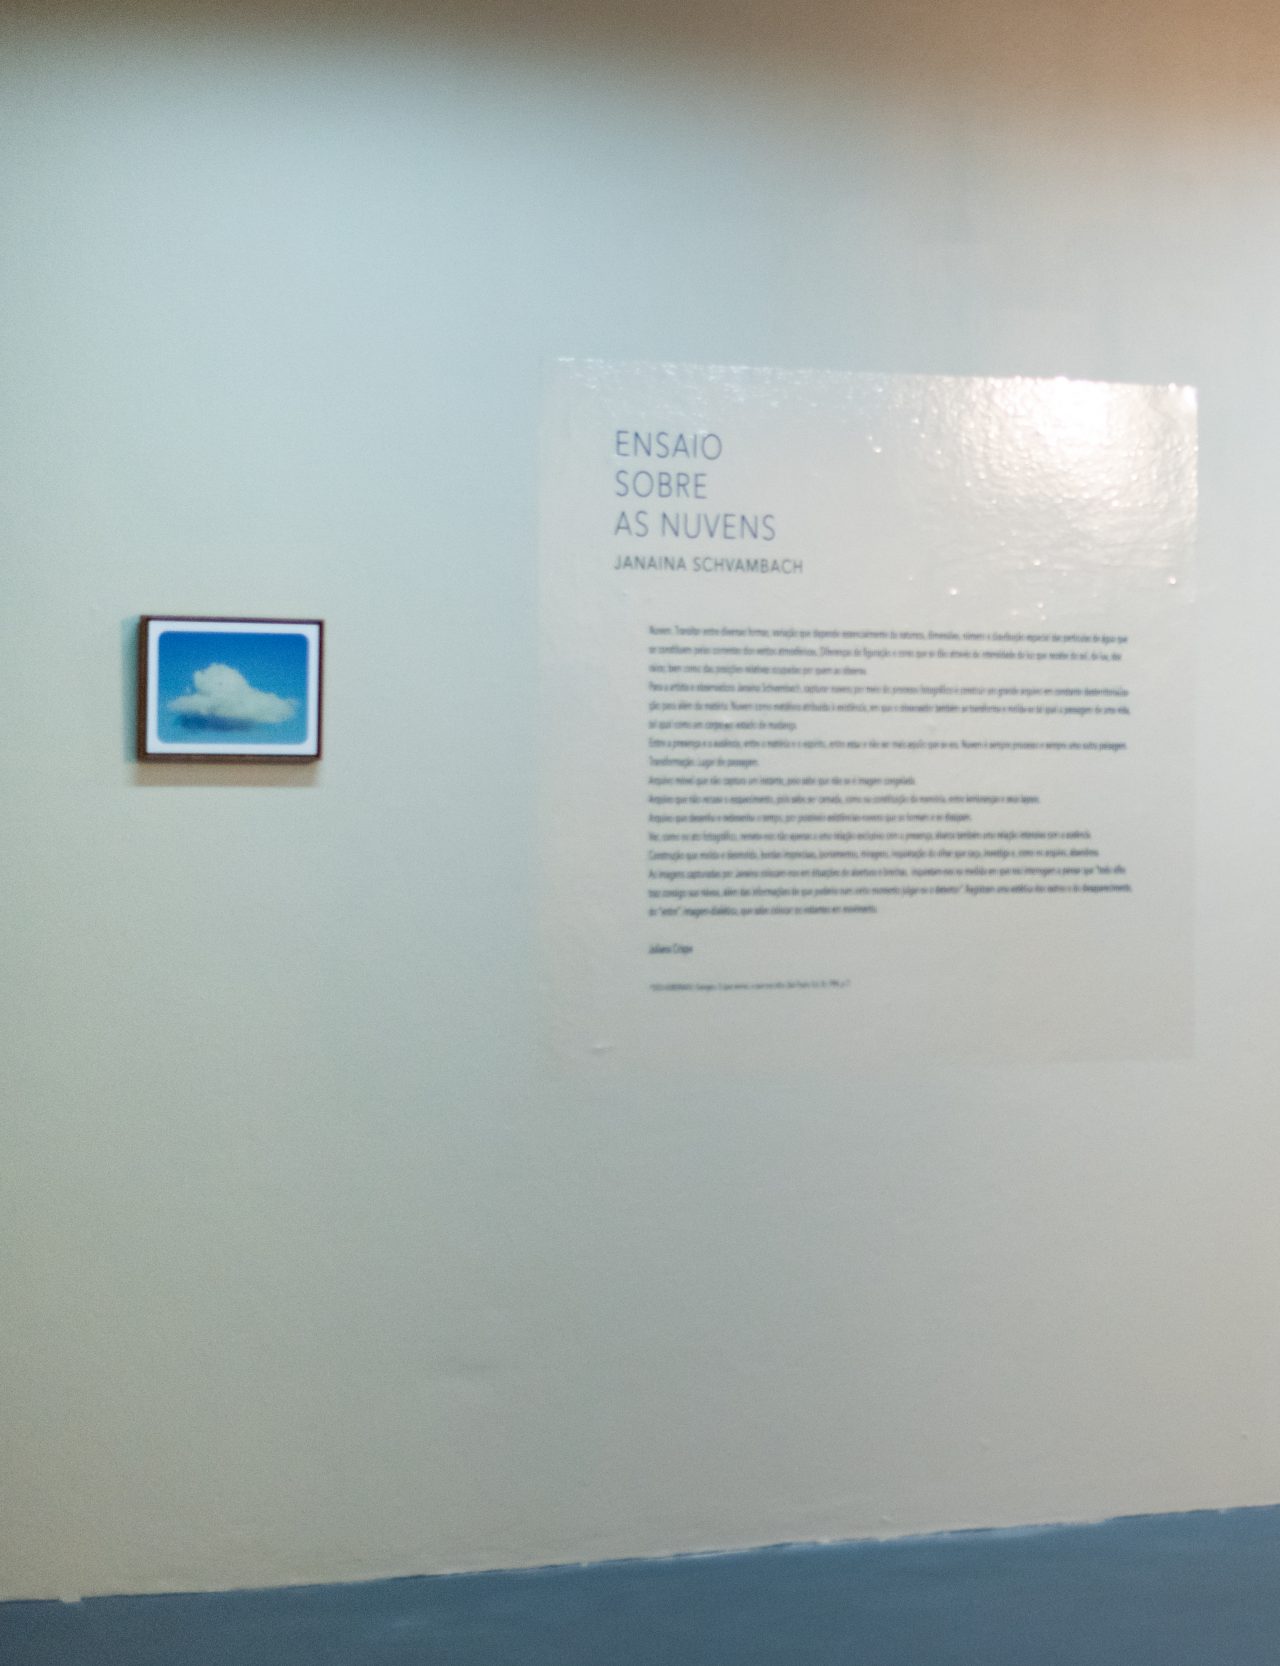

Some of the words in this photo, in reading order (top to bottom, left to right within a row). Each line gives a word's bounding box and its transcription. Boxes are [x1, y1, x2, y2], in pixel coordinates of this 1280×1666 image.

[615, 430, 723, 461] ENSAIO
[615, 470, 708, 499] SOBRE
[614, 510, 649, 537] AS
[661, 512, 776, 541] NUVENS
[614, 555, 687, 571] JANAINA
[693, 557, 803, 574] SCHVAMBACH
